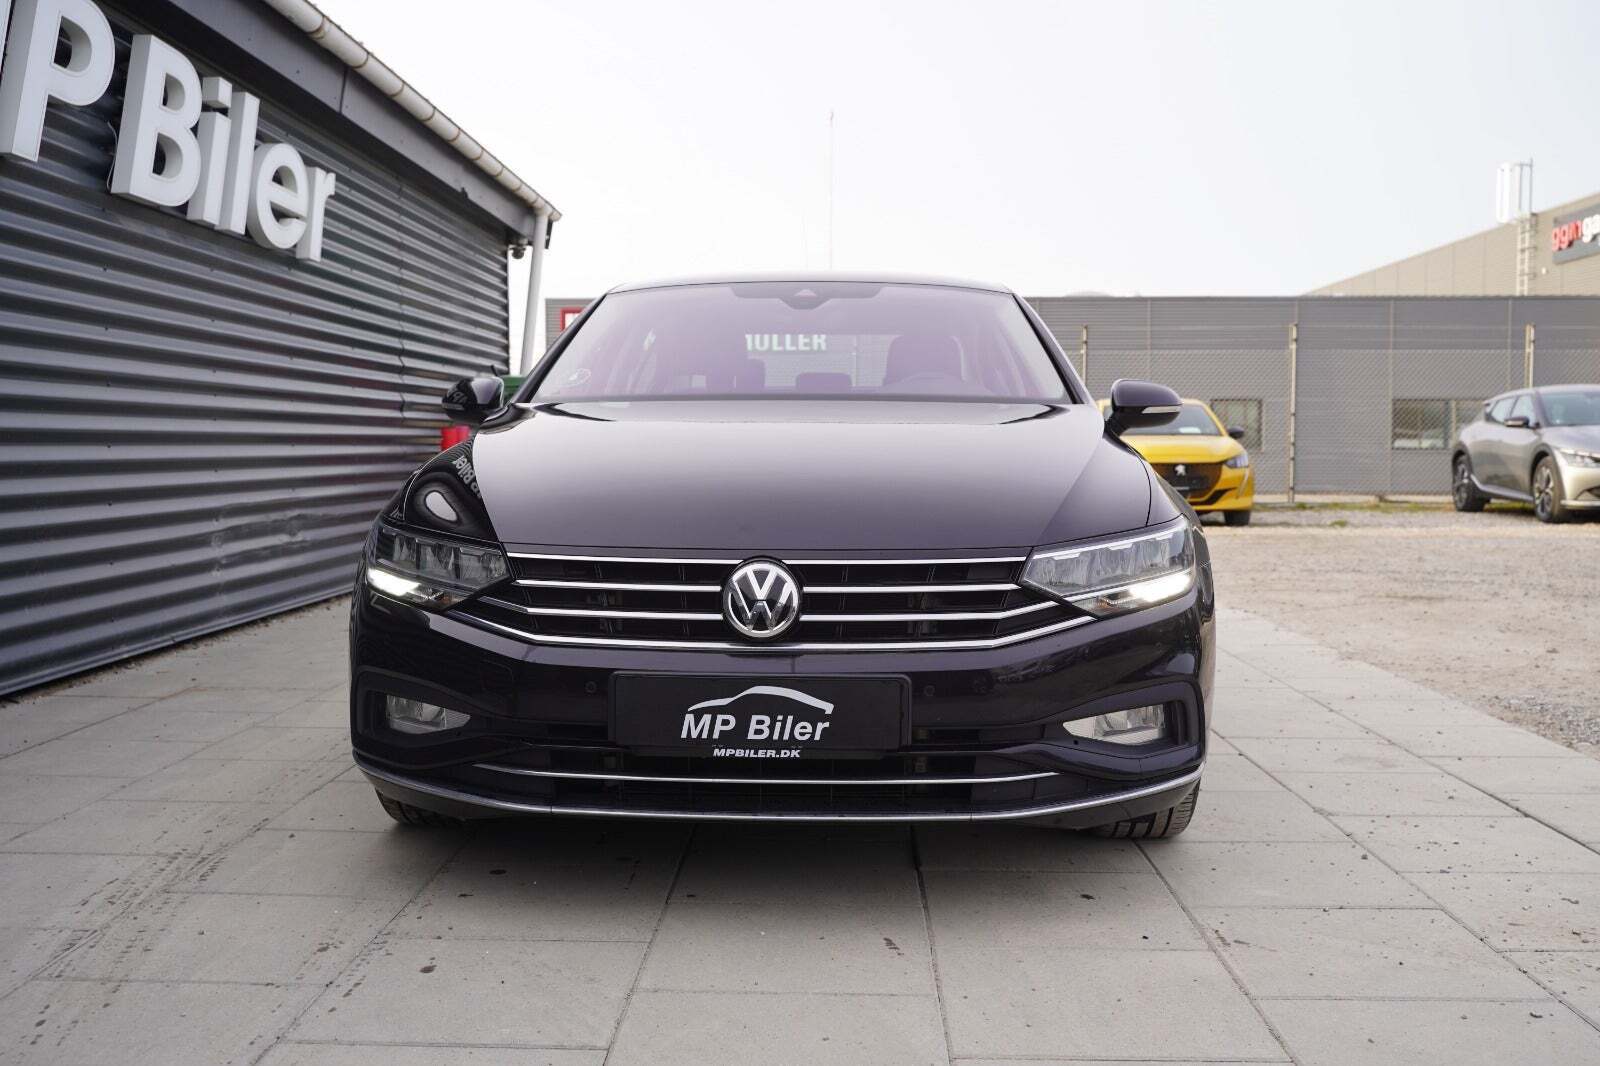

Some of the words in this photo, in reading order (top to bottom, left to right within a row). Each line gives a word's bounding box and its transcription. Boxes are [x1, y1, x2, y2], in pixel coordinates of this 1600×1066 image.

[0, 0, 115, 161] P
[111, 34, 336, 262] Biler
[725, 562, 799, 637] VW
[680, 713, 737, 739] MP
[747, 714, 830, 741] Biler
[712, 748, 801, 758] MPBILER.DK
